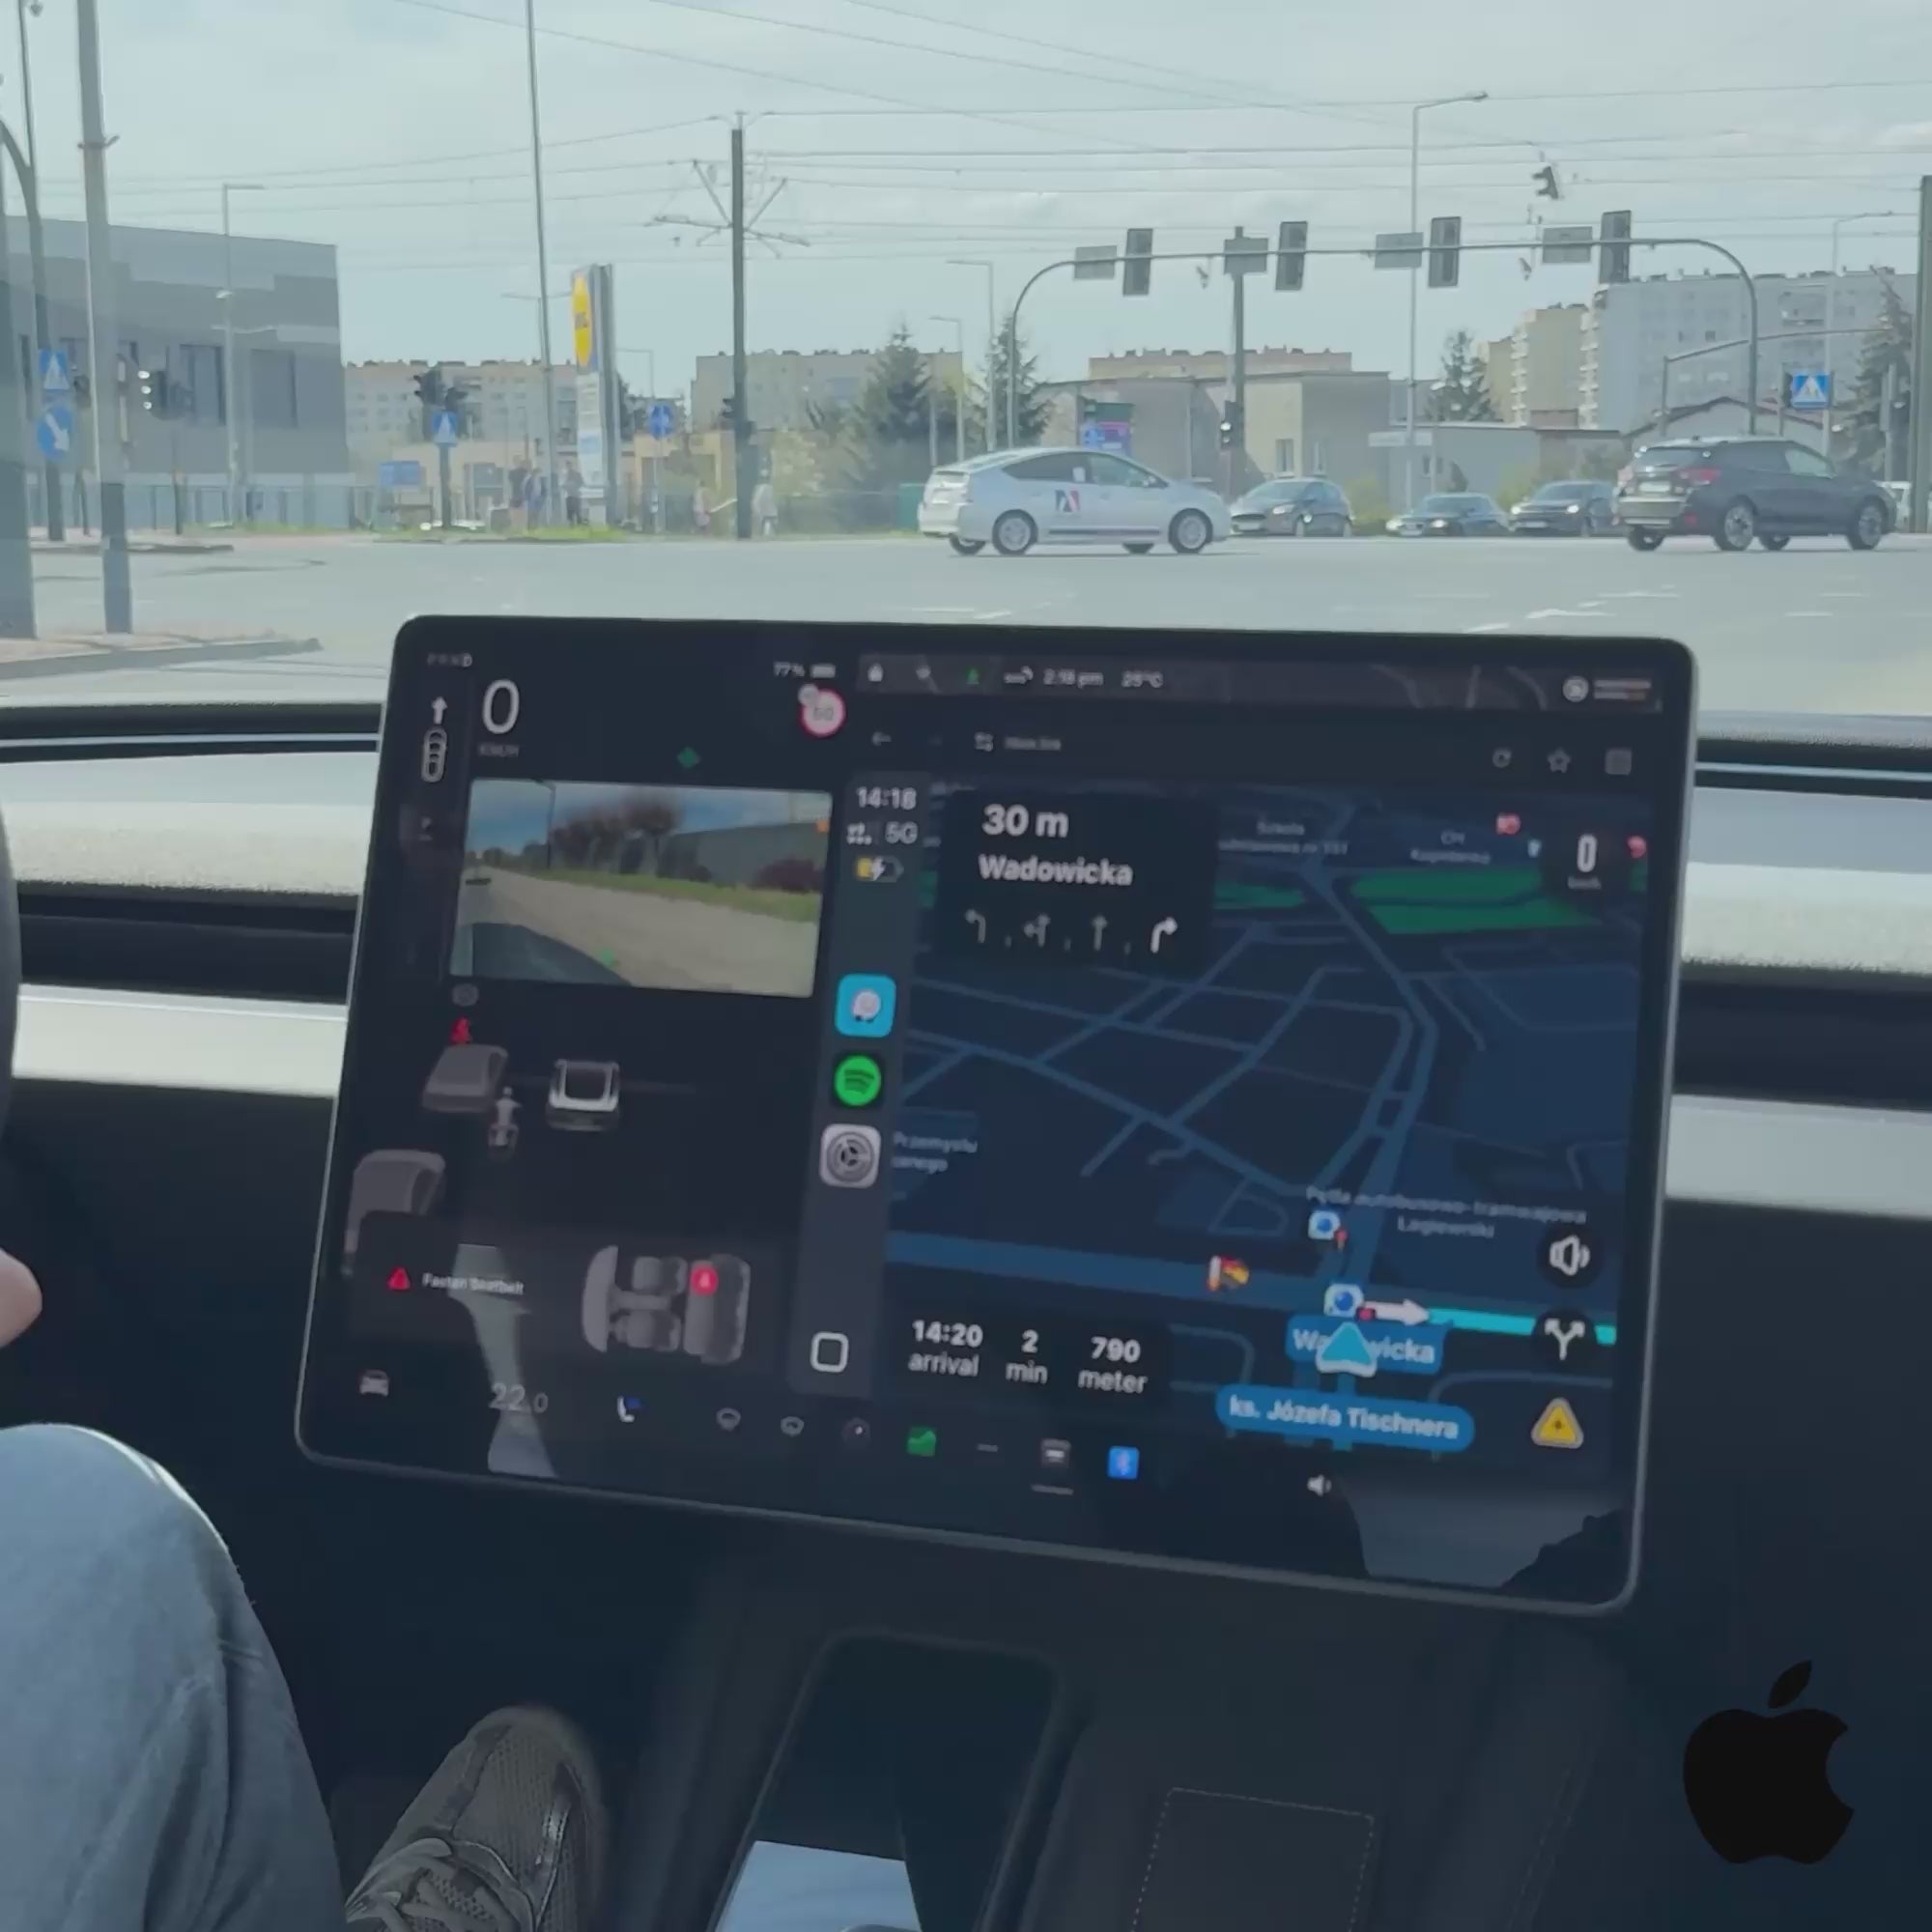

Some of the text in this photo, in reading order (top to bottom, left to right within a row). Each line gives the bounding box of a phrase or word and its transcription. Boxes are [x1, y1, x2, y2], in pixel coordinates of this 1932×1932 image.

[483, 679, 520, 735] 0
[981, 803, 1069, 838] 30 m
[1577, 834, 1597, 872] 0
[978, 853, 1134, 886] Wadowicka
[911, 1320, 983, 1348] 14:20
[1021, 1329, 1038, 1353] 2
[1293, 1328, 1435, 1364] Wawicka
[908, 1351, 980, 1377] arrival
[1091, 1336, 1141, 1363] 790
[1005, 1359, 1048, 1384] min
[1077, 1369, 1149, 1394] meter
[1230, 1394, 1460, 1439] ks. Józefa Tischnera
